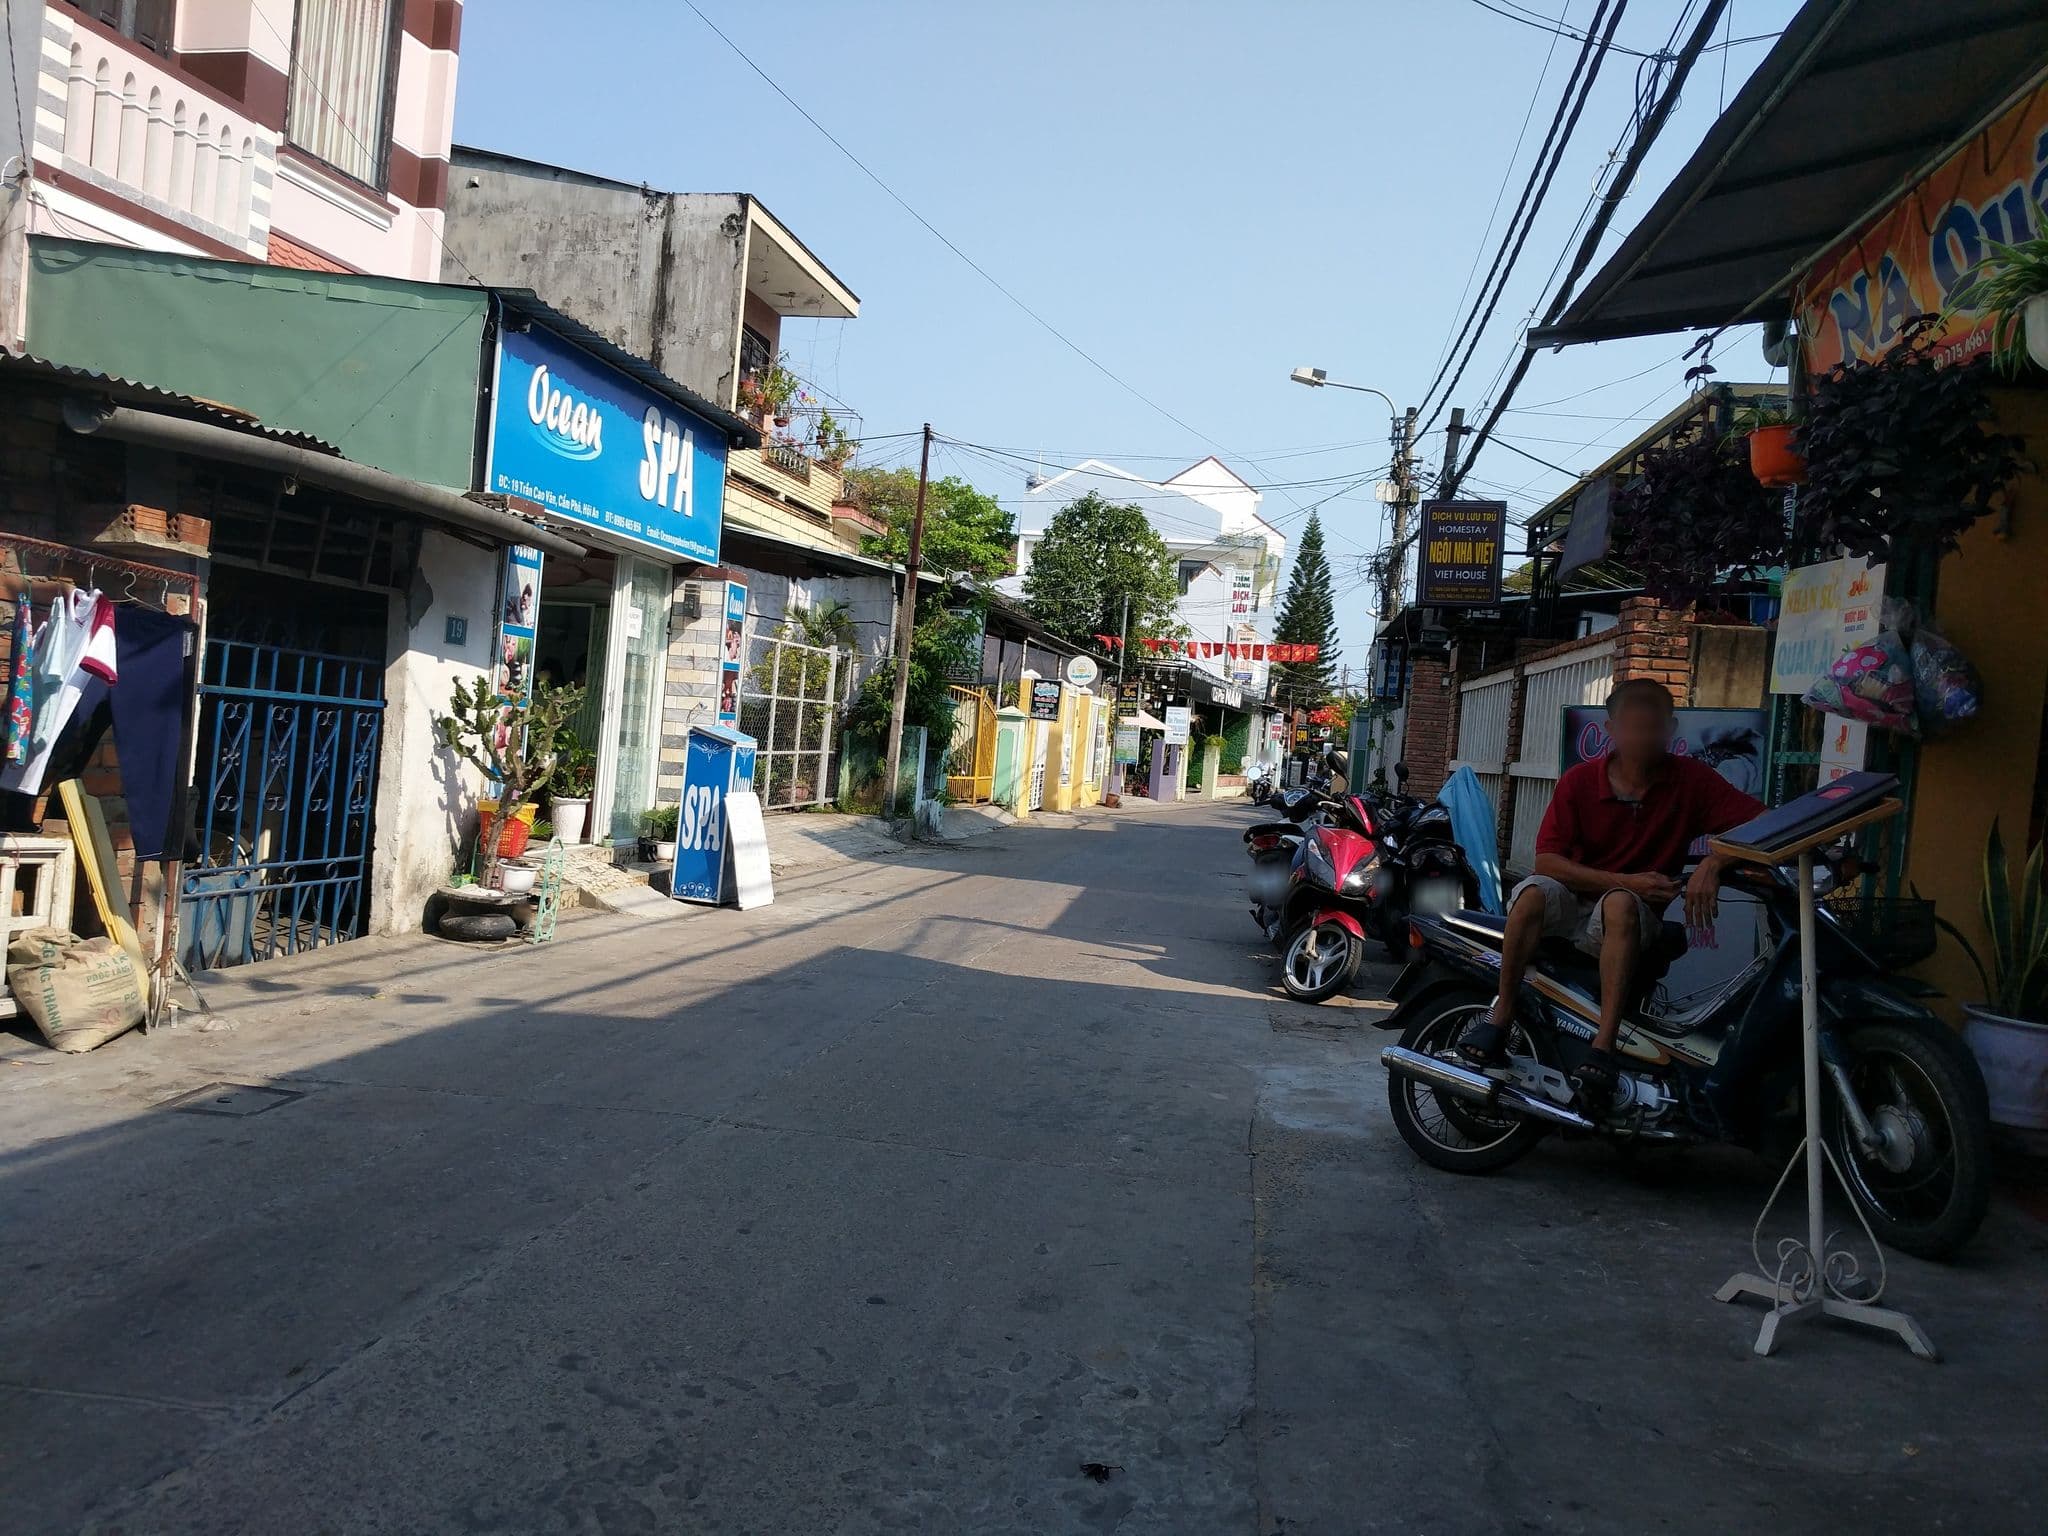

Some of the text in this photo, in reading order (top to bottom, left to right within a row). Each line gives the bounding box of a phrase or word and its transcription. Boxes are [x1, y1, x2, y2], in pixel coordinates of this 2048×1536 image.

[528, 363, 696, 517] Ocean SPA
[511, 479, 519, 492] 19
[533, 486, 545, 501] Cao
[1438, 525, 1488, 534] HOMESTAY
[1429, 537, 1495, 569] NGÔI NHÀ VIỆT
[1434, 570, 1488, 580] VIET HOUSE
[728, 592, 743, 617] Ocean
[681, 783, 721, 851] SPA
[42, 983, 64, 1030] THANH
[1555, 1016, 1592, 1041] YAMAHA
